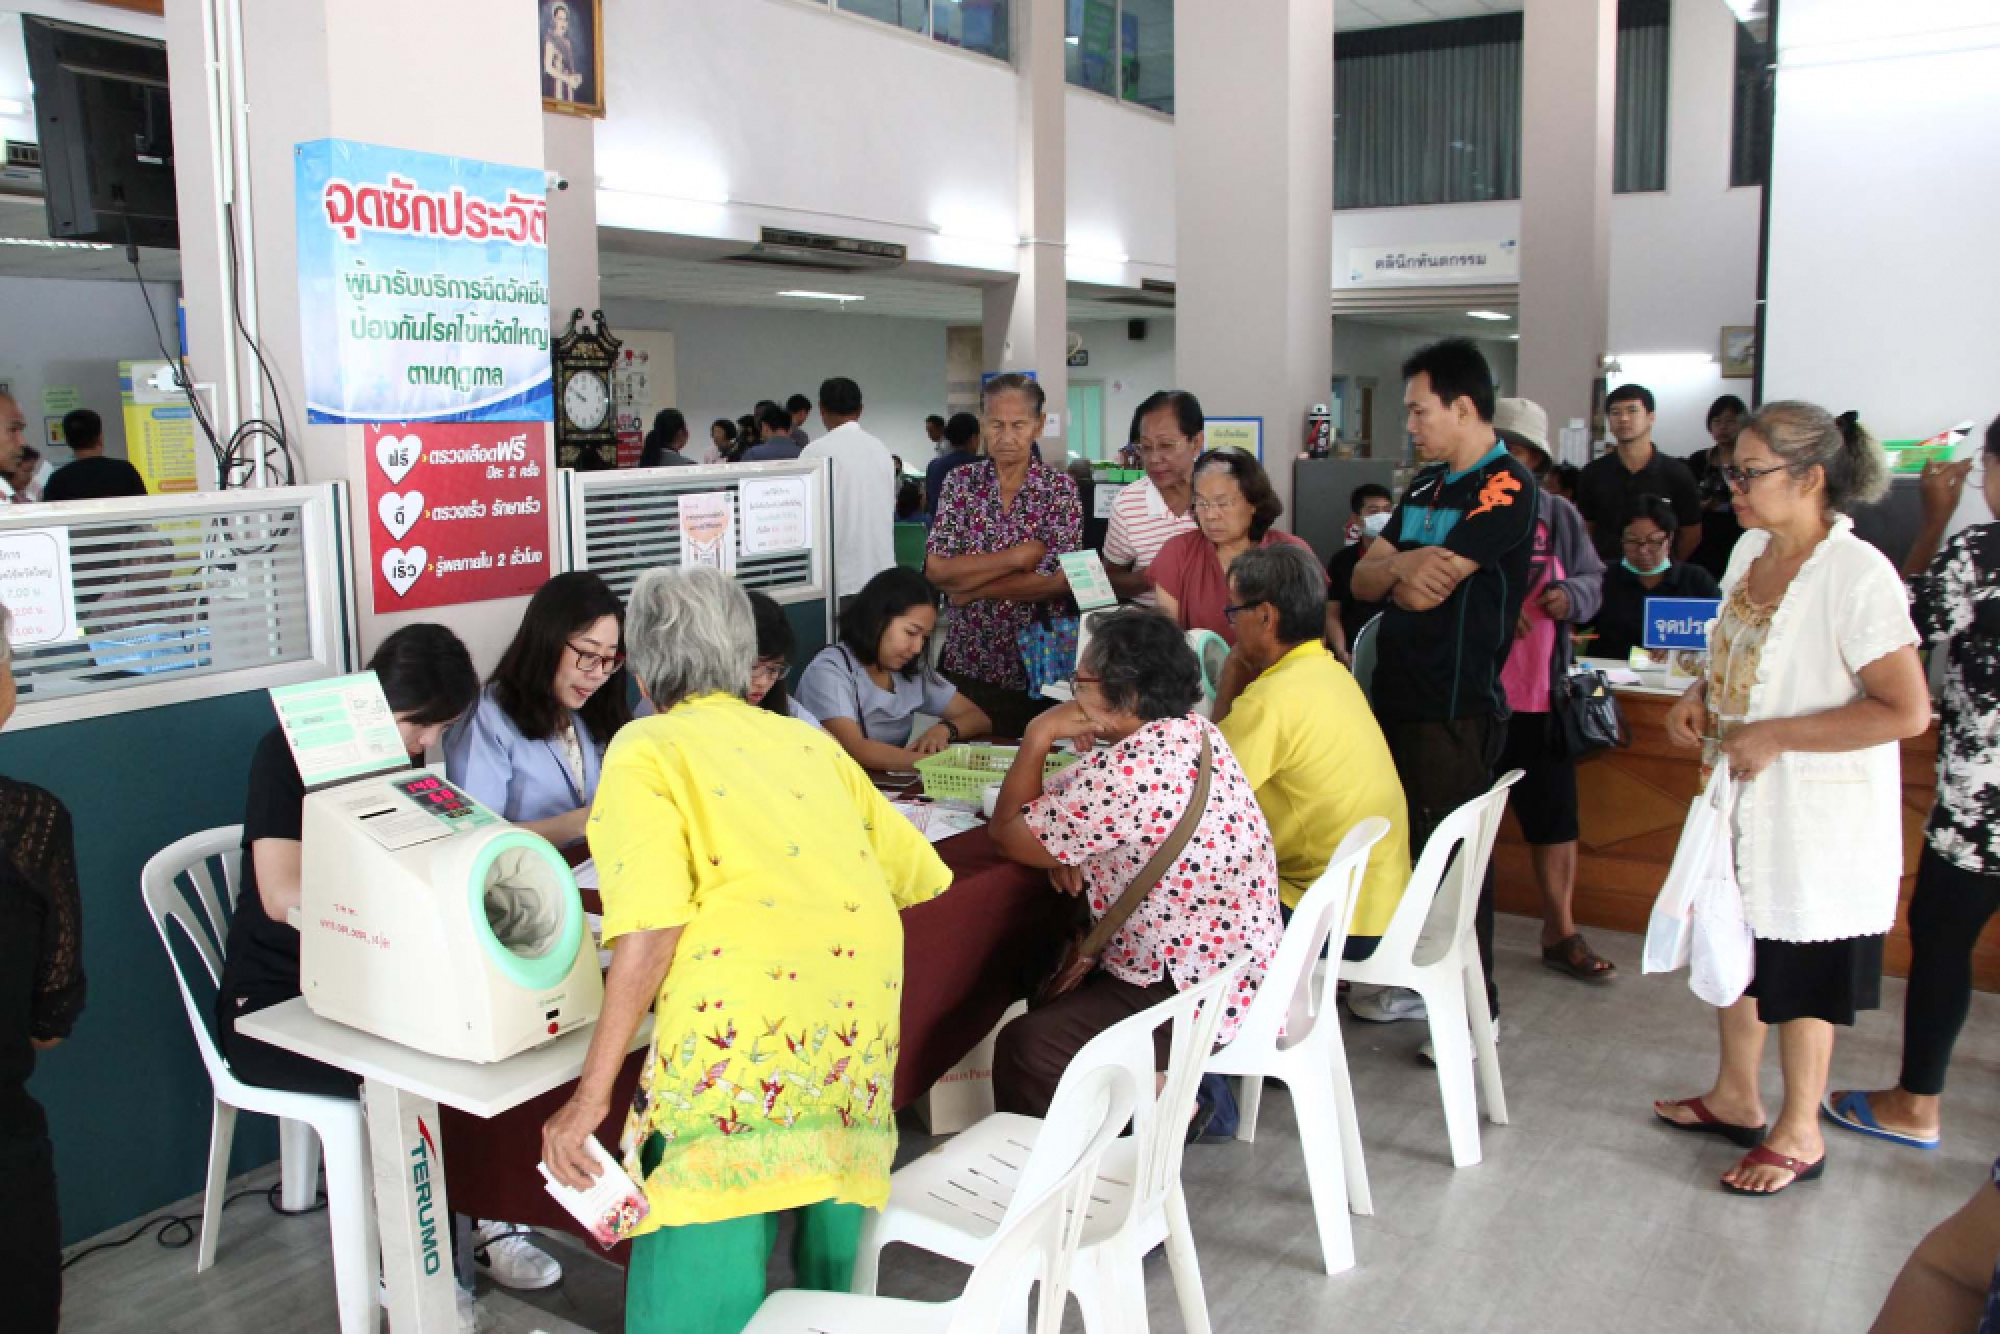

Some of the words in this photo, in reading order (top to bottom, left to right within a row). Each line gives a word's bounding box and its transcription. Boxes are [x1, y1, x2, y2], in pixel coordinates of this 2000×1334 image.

[1375, 252, 1487, 270] คลินิกทันตกรรม
[407, 365, 503, 392] ตามฤดูกาล
[411, 1137, 441, 1276] TERUMO
